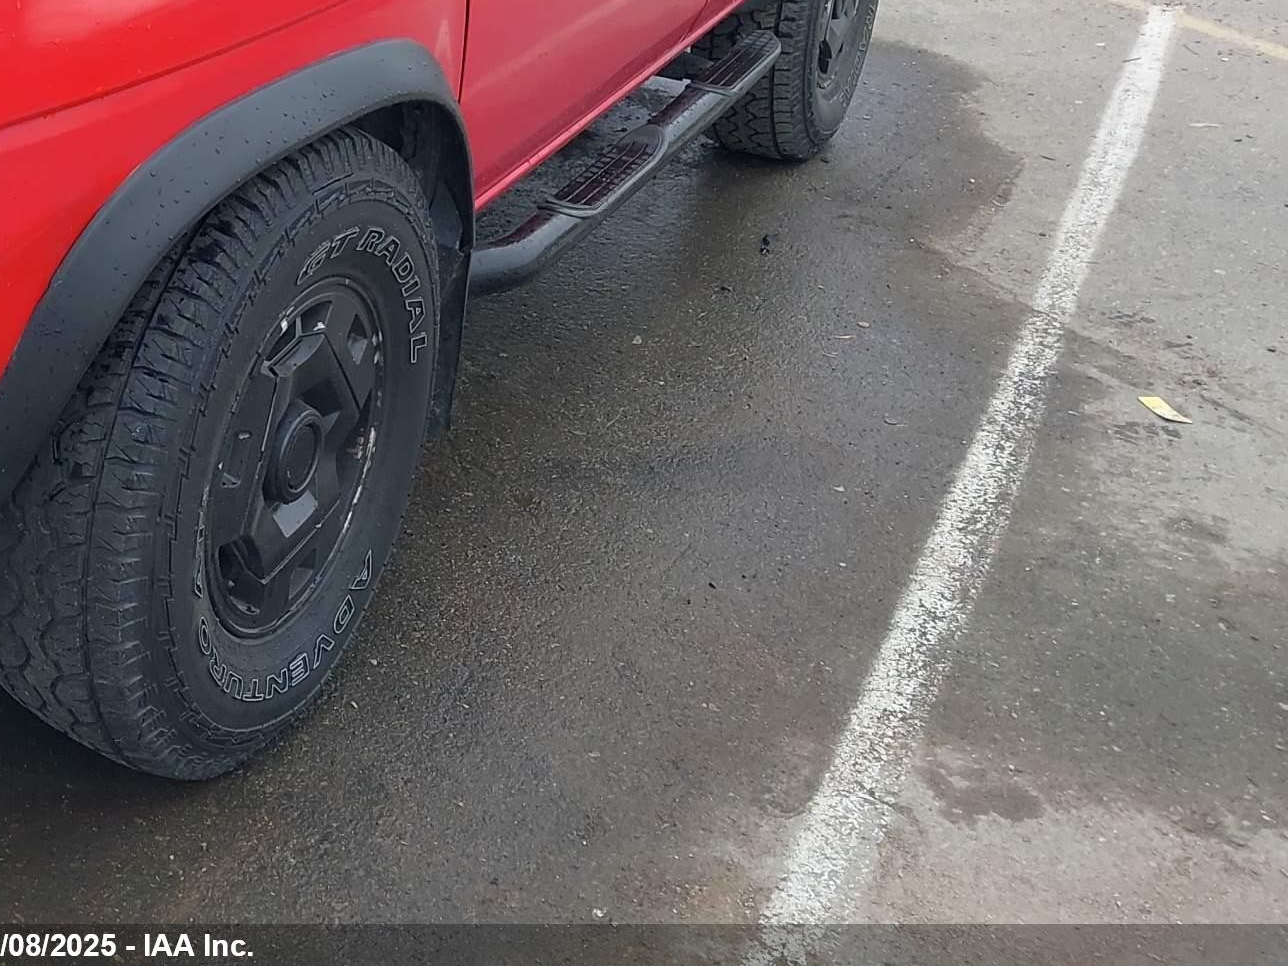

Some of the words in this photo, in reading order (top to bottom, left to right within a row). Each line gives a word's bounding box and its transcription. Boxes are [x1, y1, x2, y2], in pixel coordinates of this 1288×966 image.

[297, 226, 360, 285] GT
[356, 226, 428, 364] RADIAL
[198, 548, 373, 702] ADVENTURO
